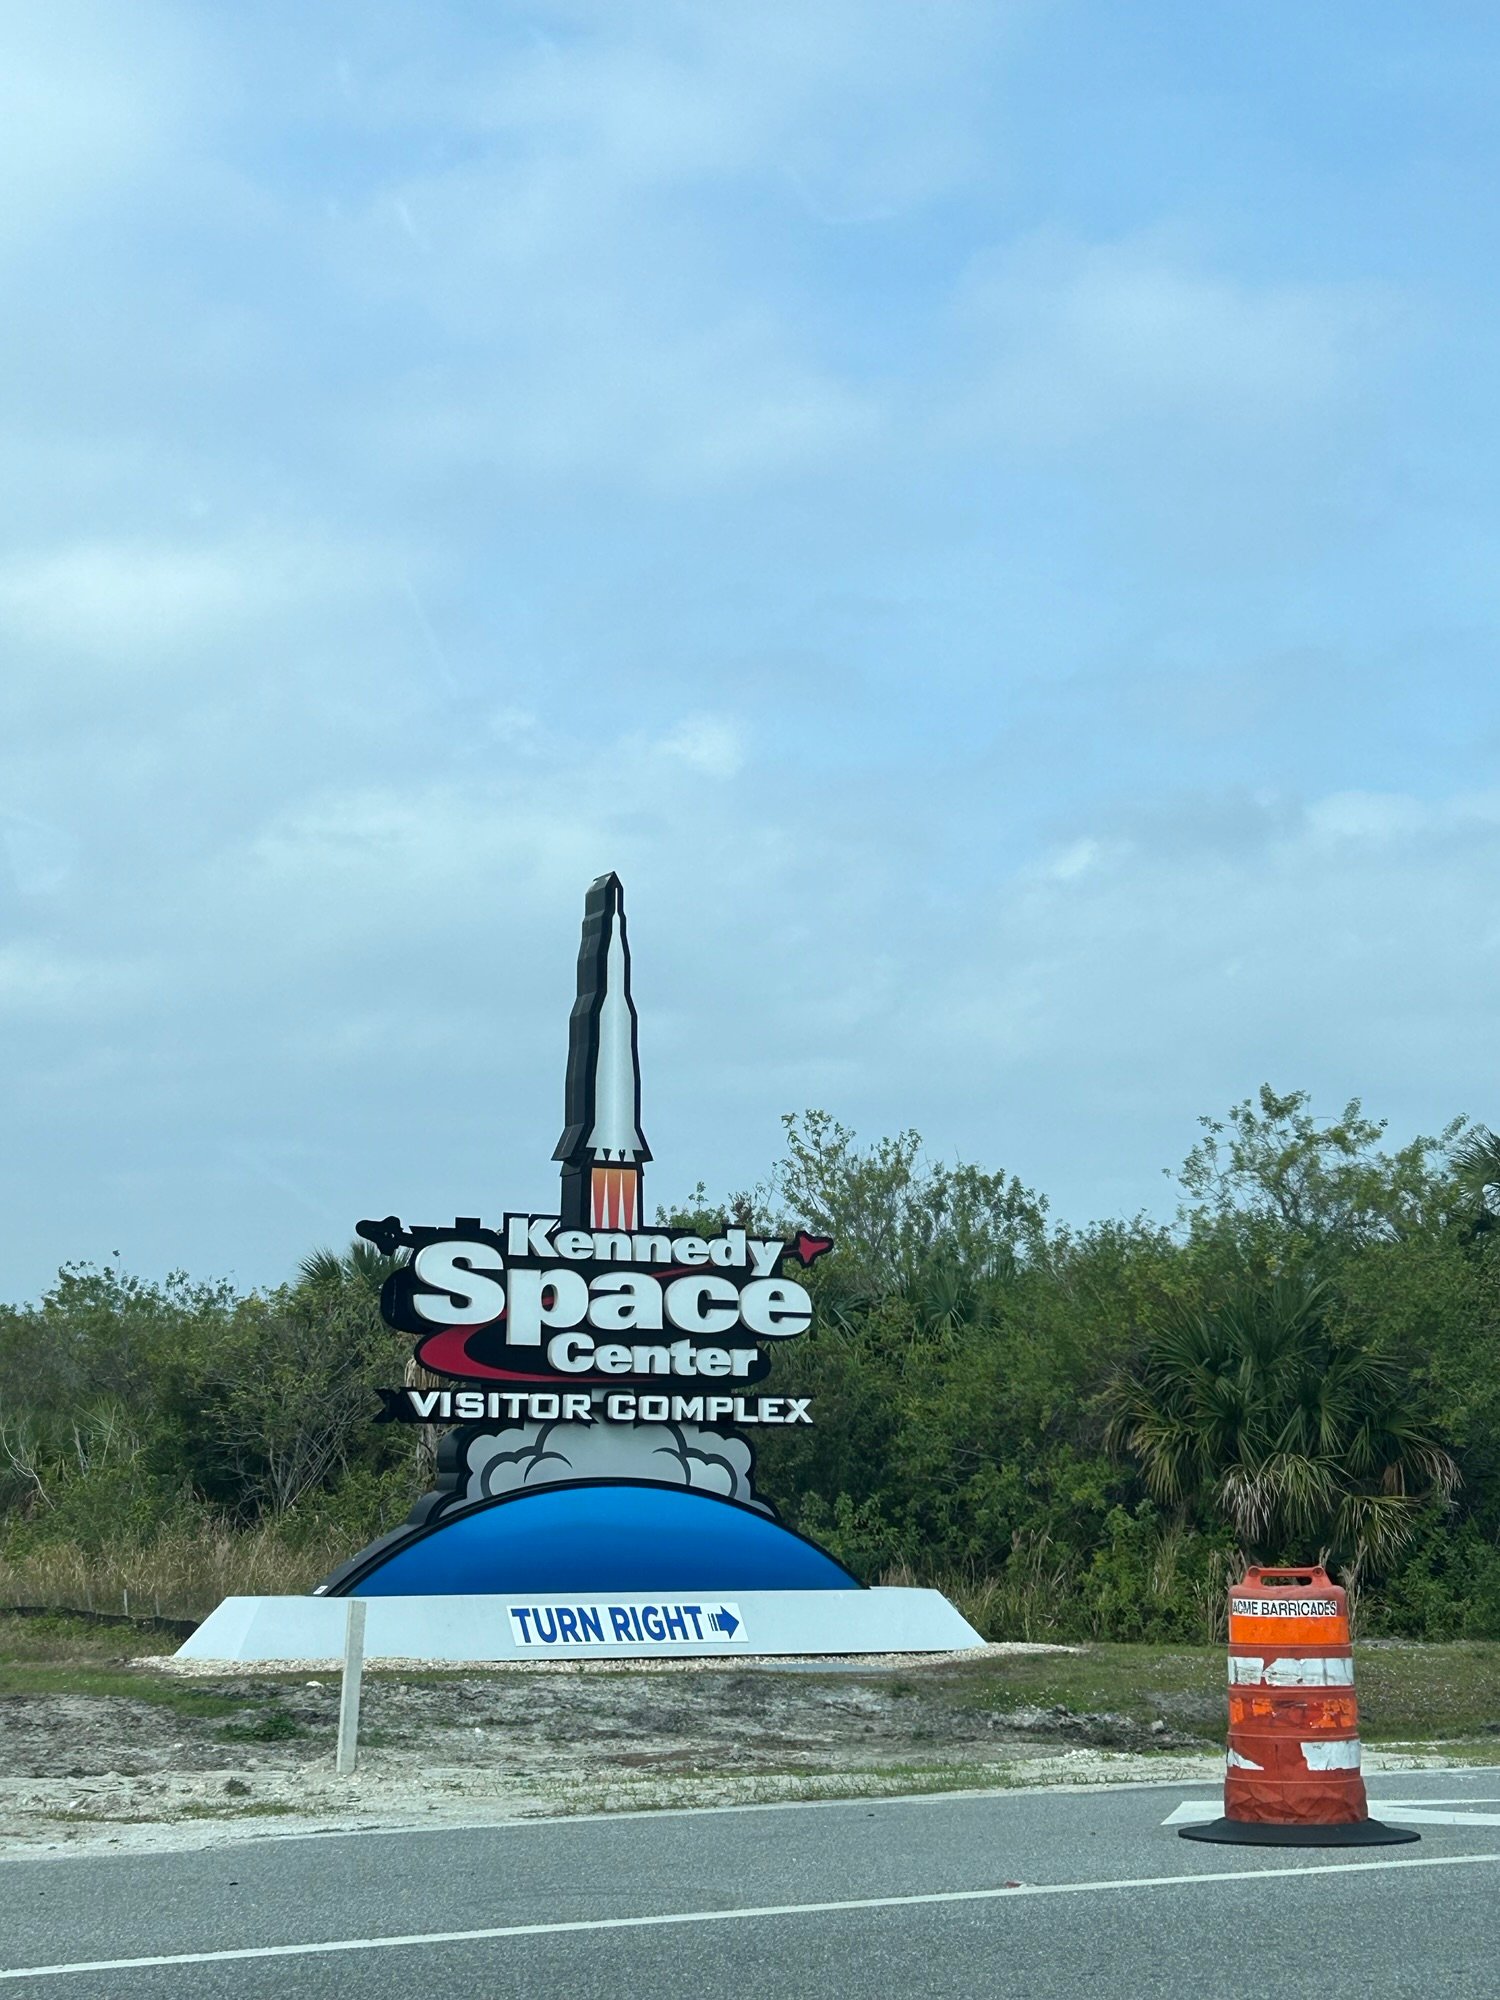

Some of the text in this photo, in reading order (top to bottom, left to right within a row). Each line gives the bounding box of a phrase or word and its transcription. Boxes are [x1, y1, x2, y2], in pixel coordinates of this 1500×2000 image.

[508, 1217, 784, 1276] Kennedy
[413, 1241, 812, 1345] Space
[547, 1332, 758, 1376] Center
[407, 1391, 813, 1423] VISITOR COMPLEX
[511, 1606, 703, 1643] TURN RIGHT
[1233, 1601, 1336, 1615] ACME BARRICADES
